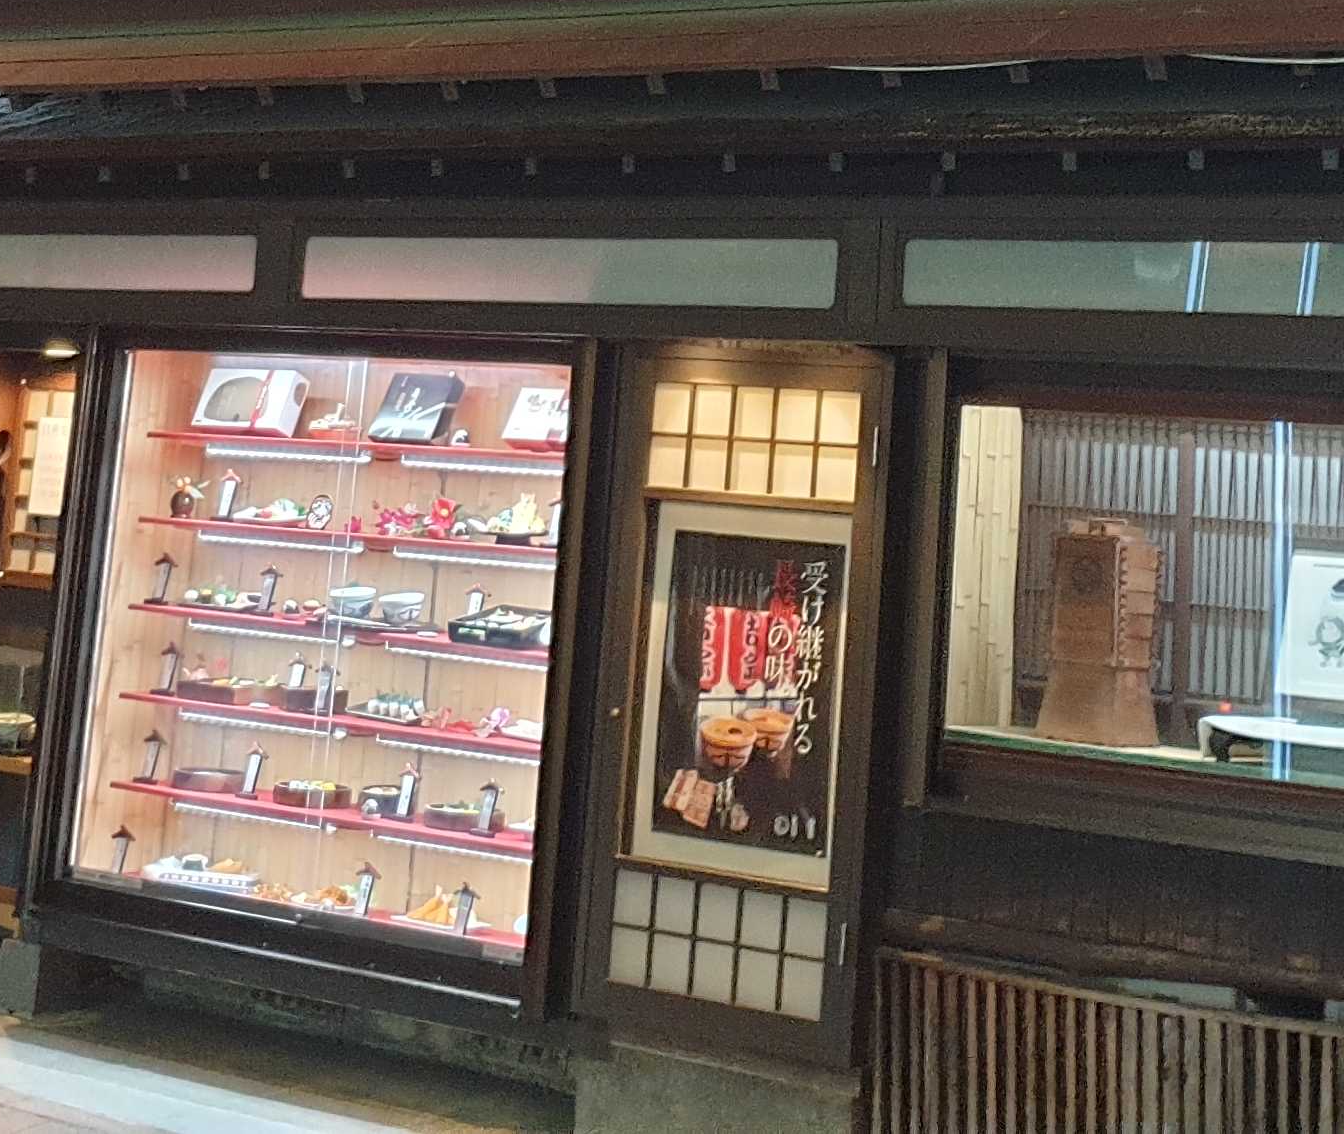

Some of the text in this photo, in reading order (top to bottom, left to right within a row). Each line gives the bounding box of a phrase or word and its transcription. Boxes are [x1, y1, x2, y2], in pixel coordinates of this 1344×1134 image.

[794, 560, 830, 755] 受け継がれる
